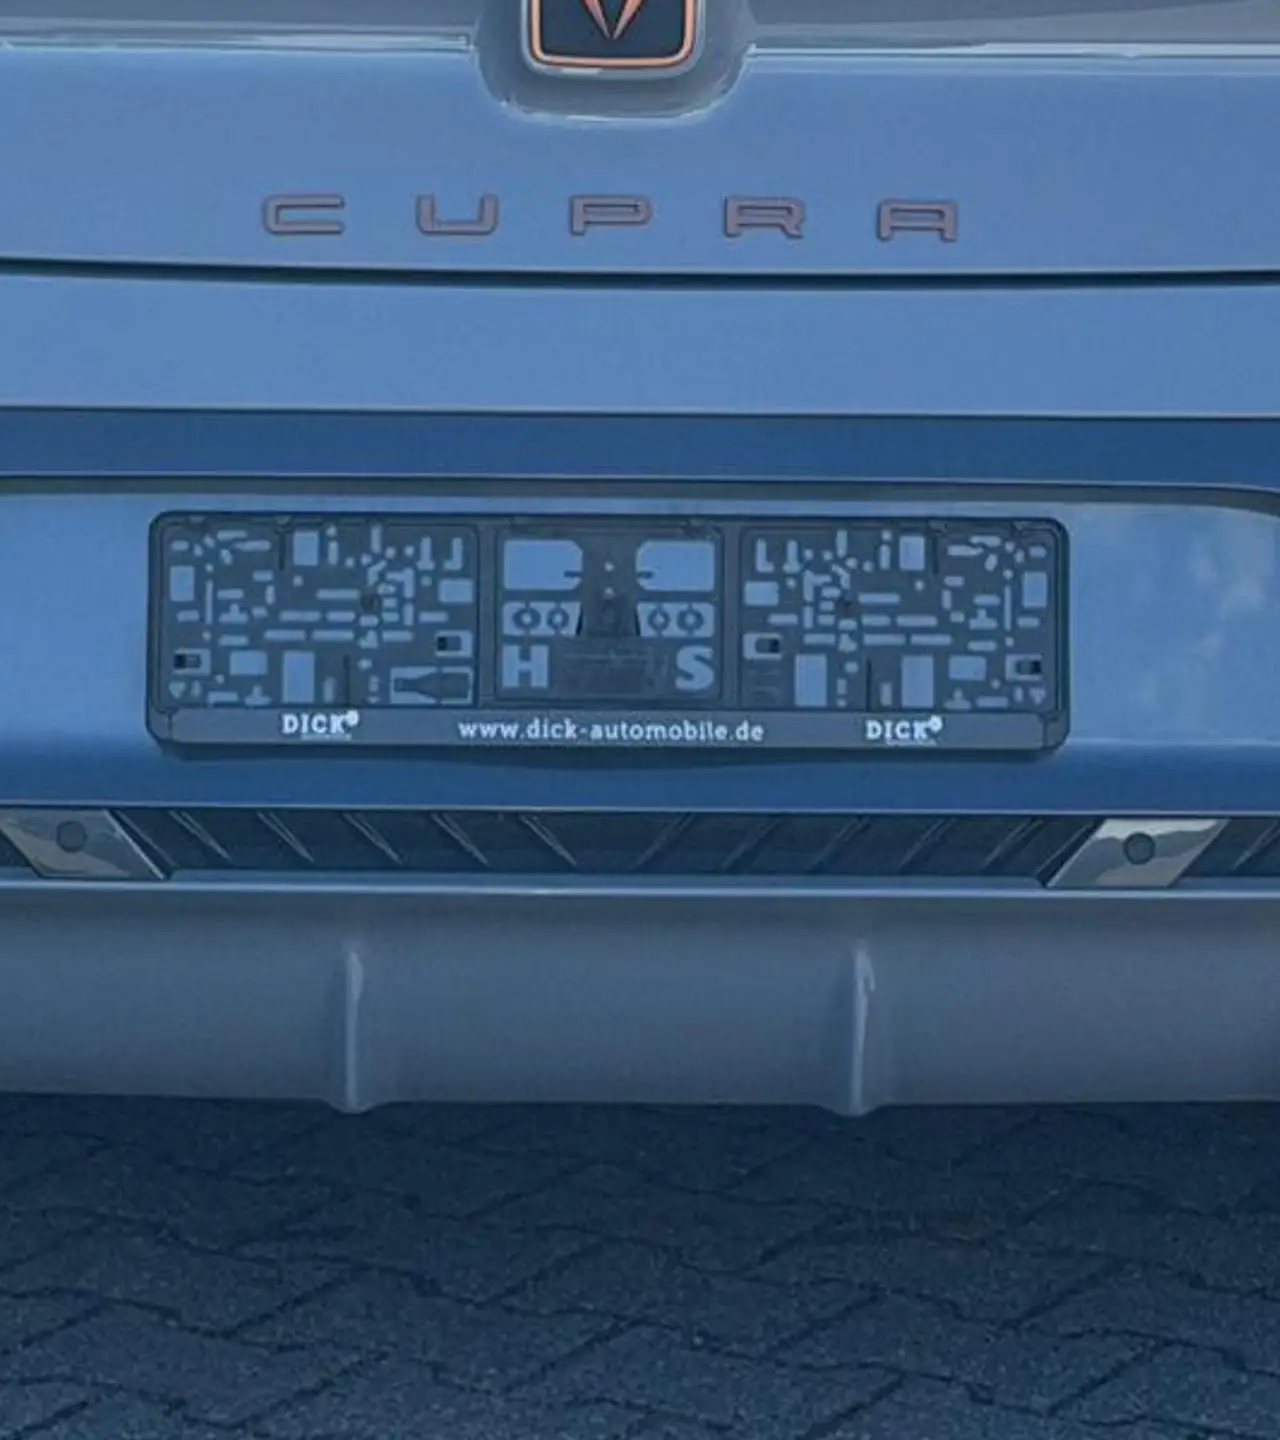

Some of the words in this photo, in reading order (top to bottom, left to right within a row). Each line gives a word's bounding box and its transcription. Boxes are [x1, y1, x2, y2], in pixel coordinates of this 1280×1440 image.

[263, 193, 960, 243] CUPRA
[282, 712, 347, 734] DICK
[457, 718, 765, 742] www.dick-automobile.de
[865, 718, 929, 741] DICK
